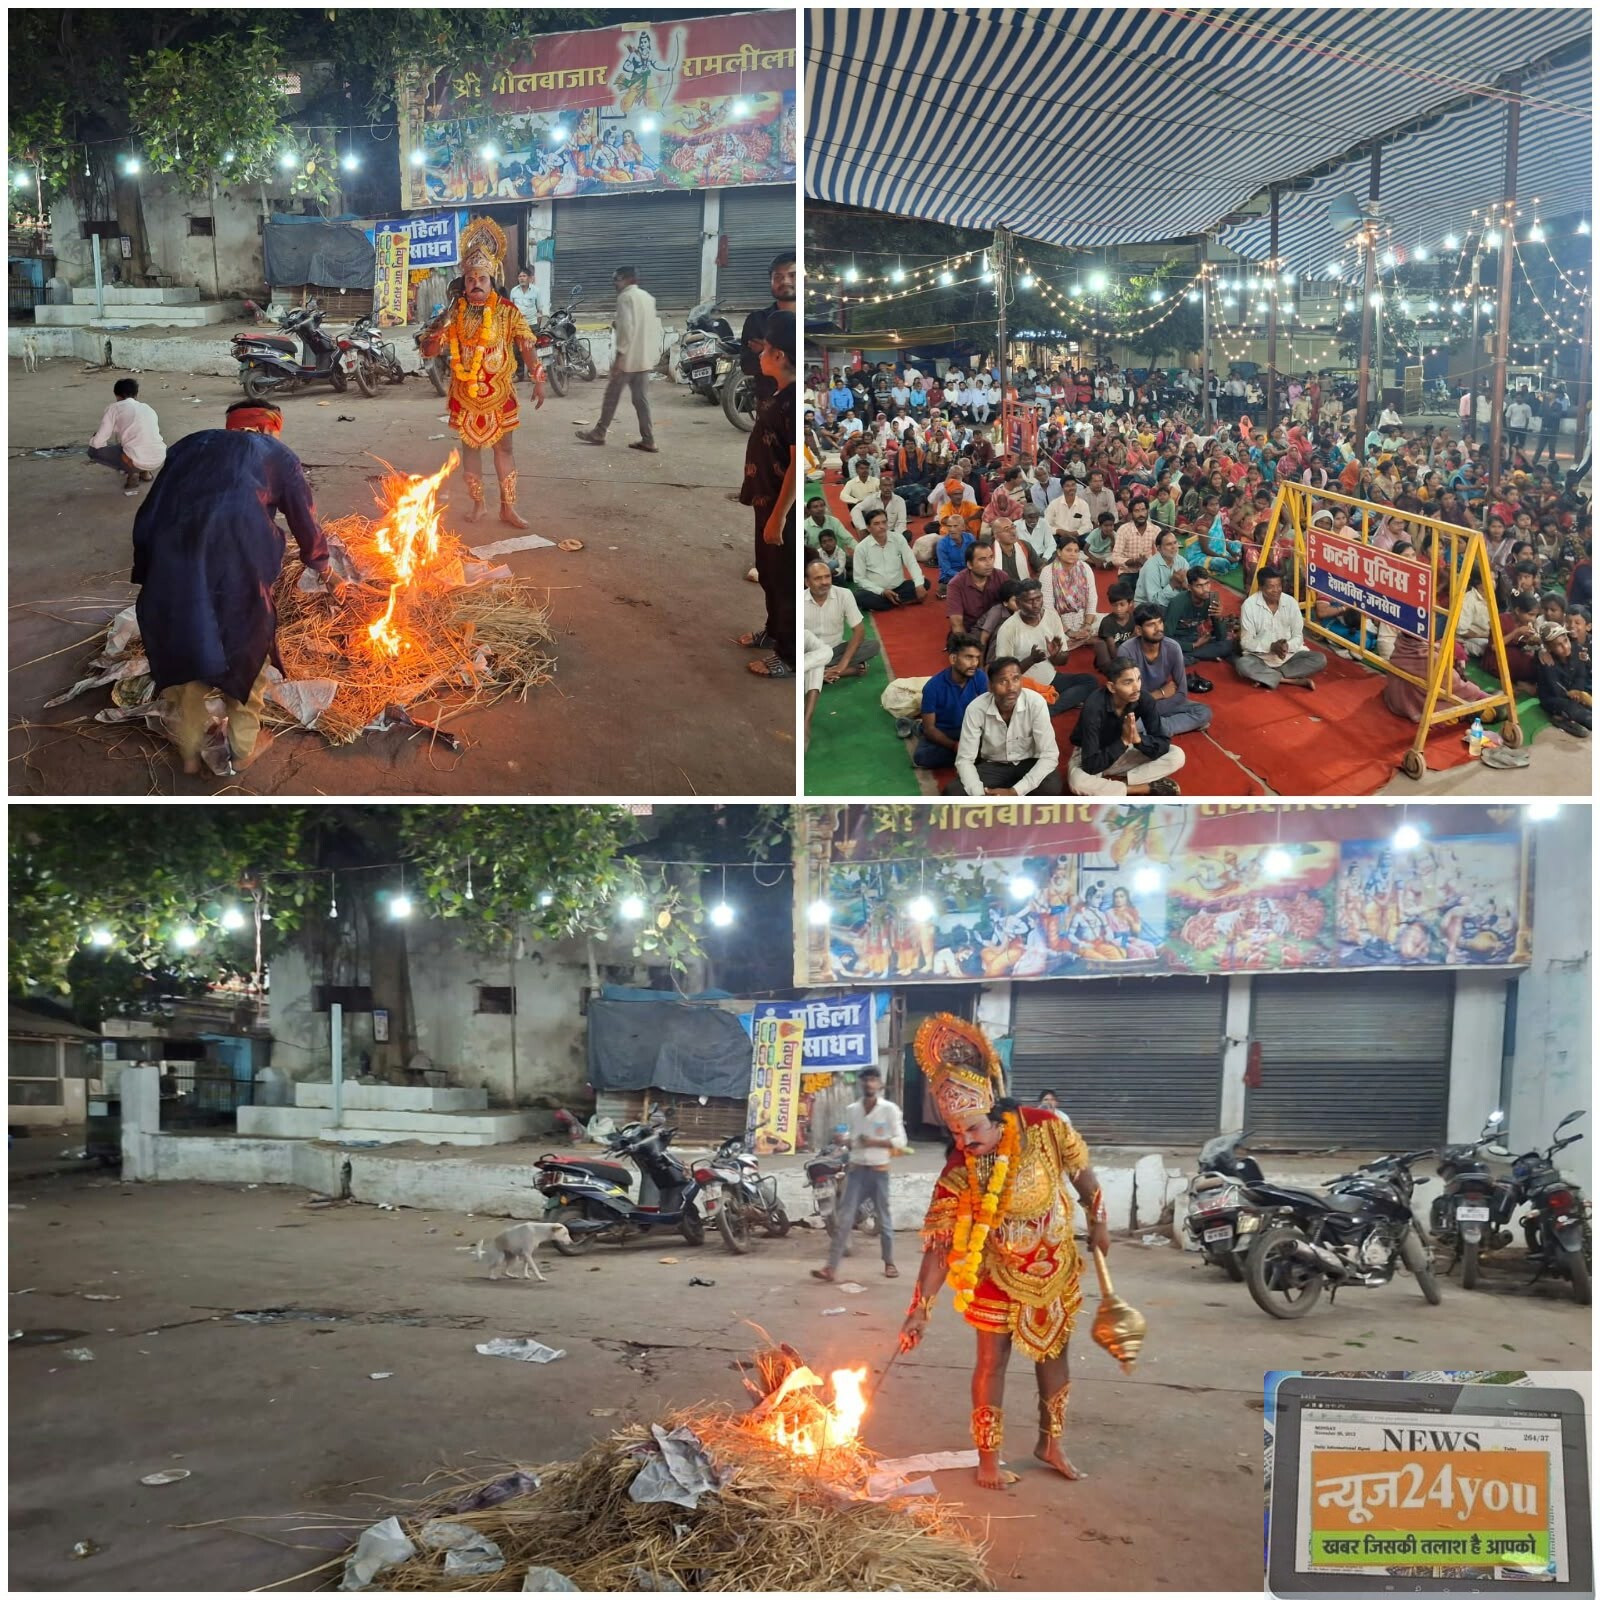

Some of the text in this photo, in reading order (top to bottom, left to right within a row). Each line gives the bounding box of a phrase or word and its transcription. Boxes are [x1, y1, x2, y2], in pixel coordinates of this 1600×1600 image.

[683, 43, 796, 77] रामलीला
[1322, 542, 1410, 594] कटनी पुलिस
